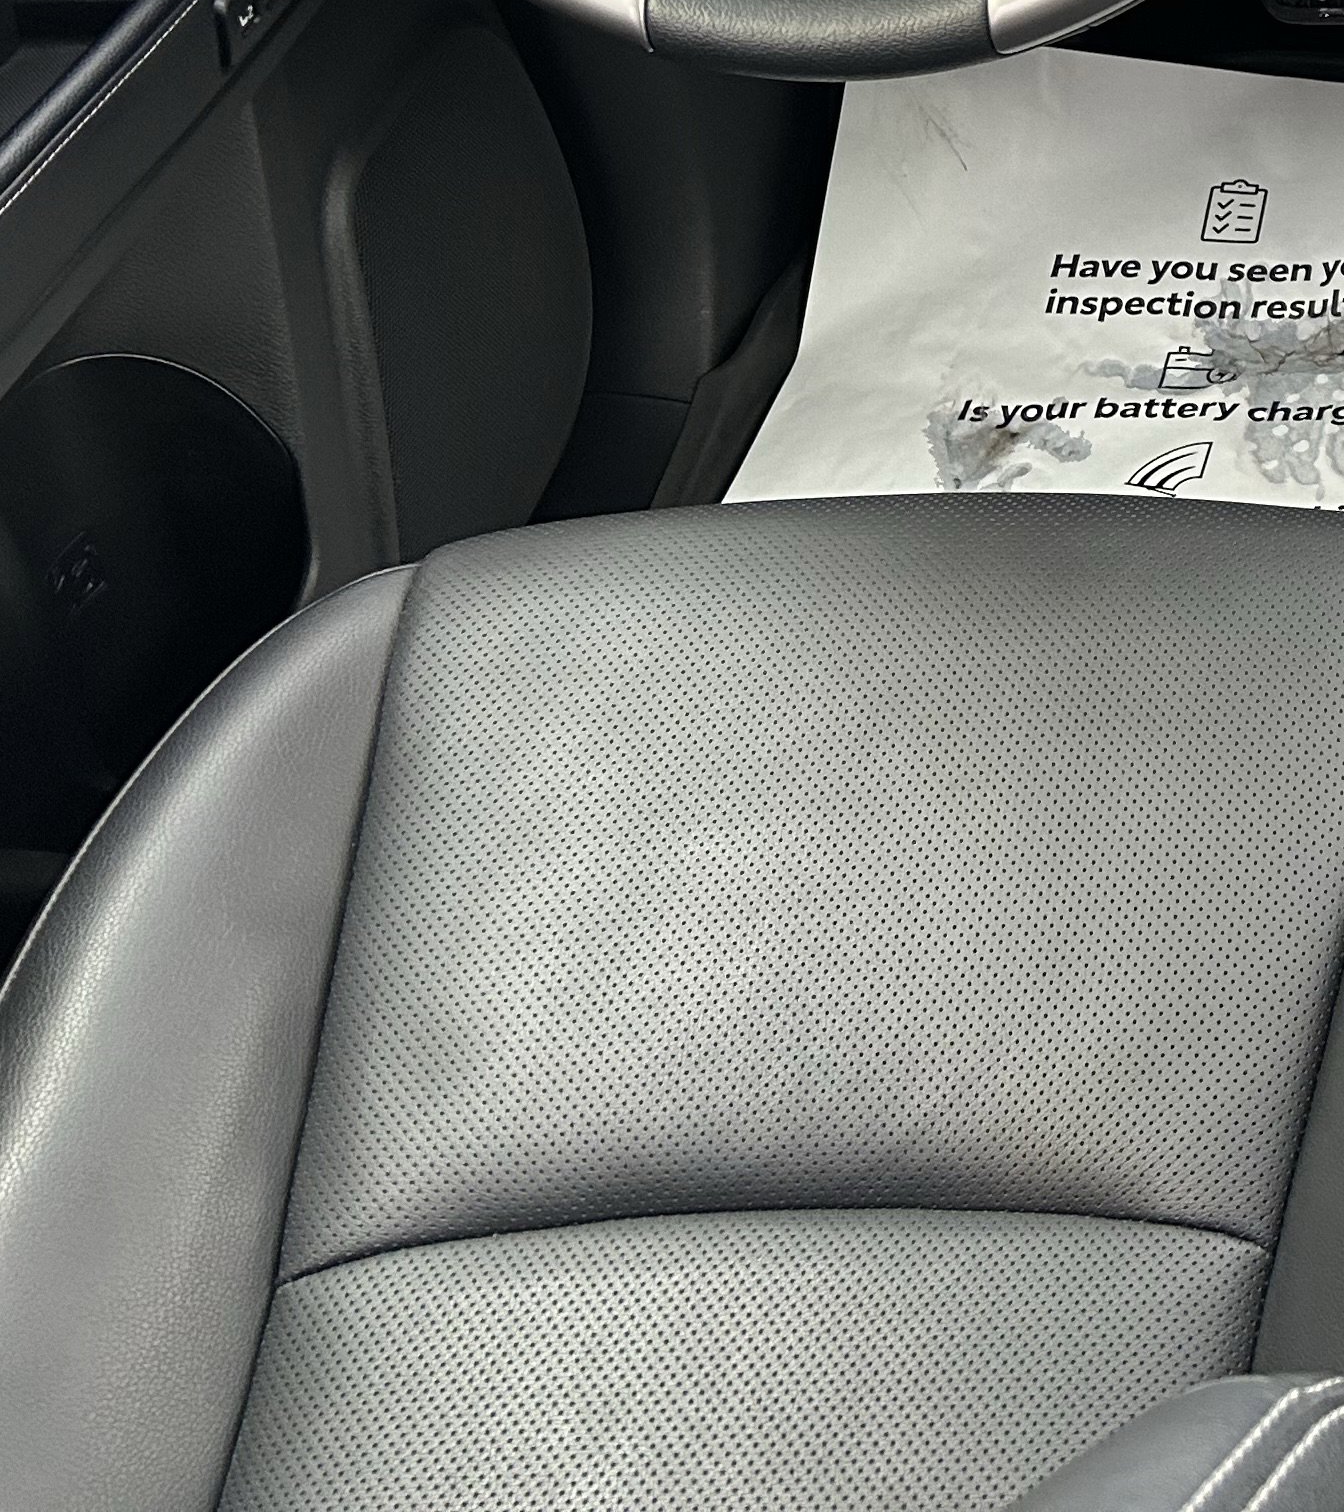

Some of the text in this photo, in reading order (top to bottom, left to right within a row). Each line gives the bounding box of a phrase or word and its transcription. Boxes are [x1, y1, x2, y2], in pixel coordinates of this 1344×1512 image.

[1050, 254, 1141, 278] Have
[1148, 257, 1218, 285] you
[1227, 262, 1313, 283] seen
[1045, 289, 1241, 322] inspection
[957, 399, 989, 424] Is
[1000, 398, 1088, 428] your
[1094, 397, 1241, 422] battery
